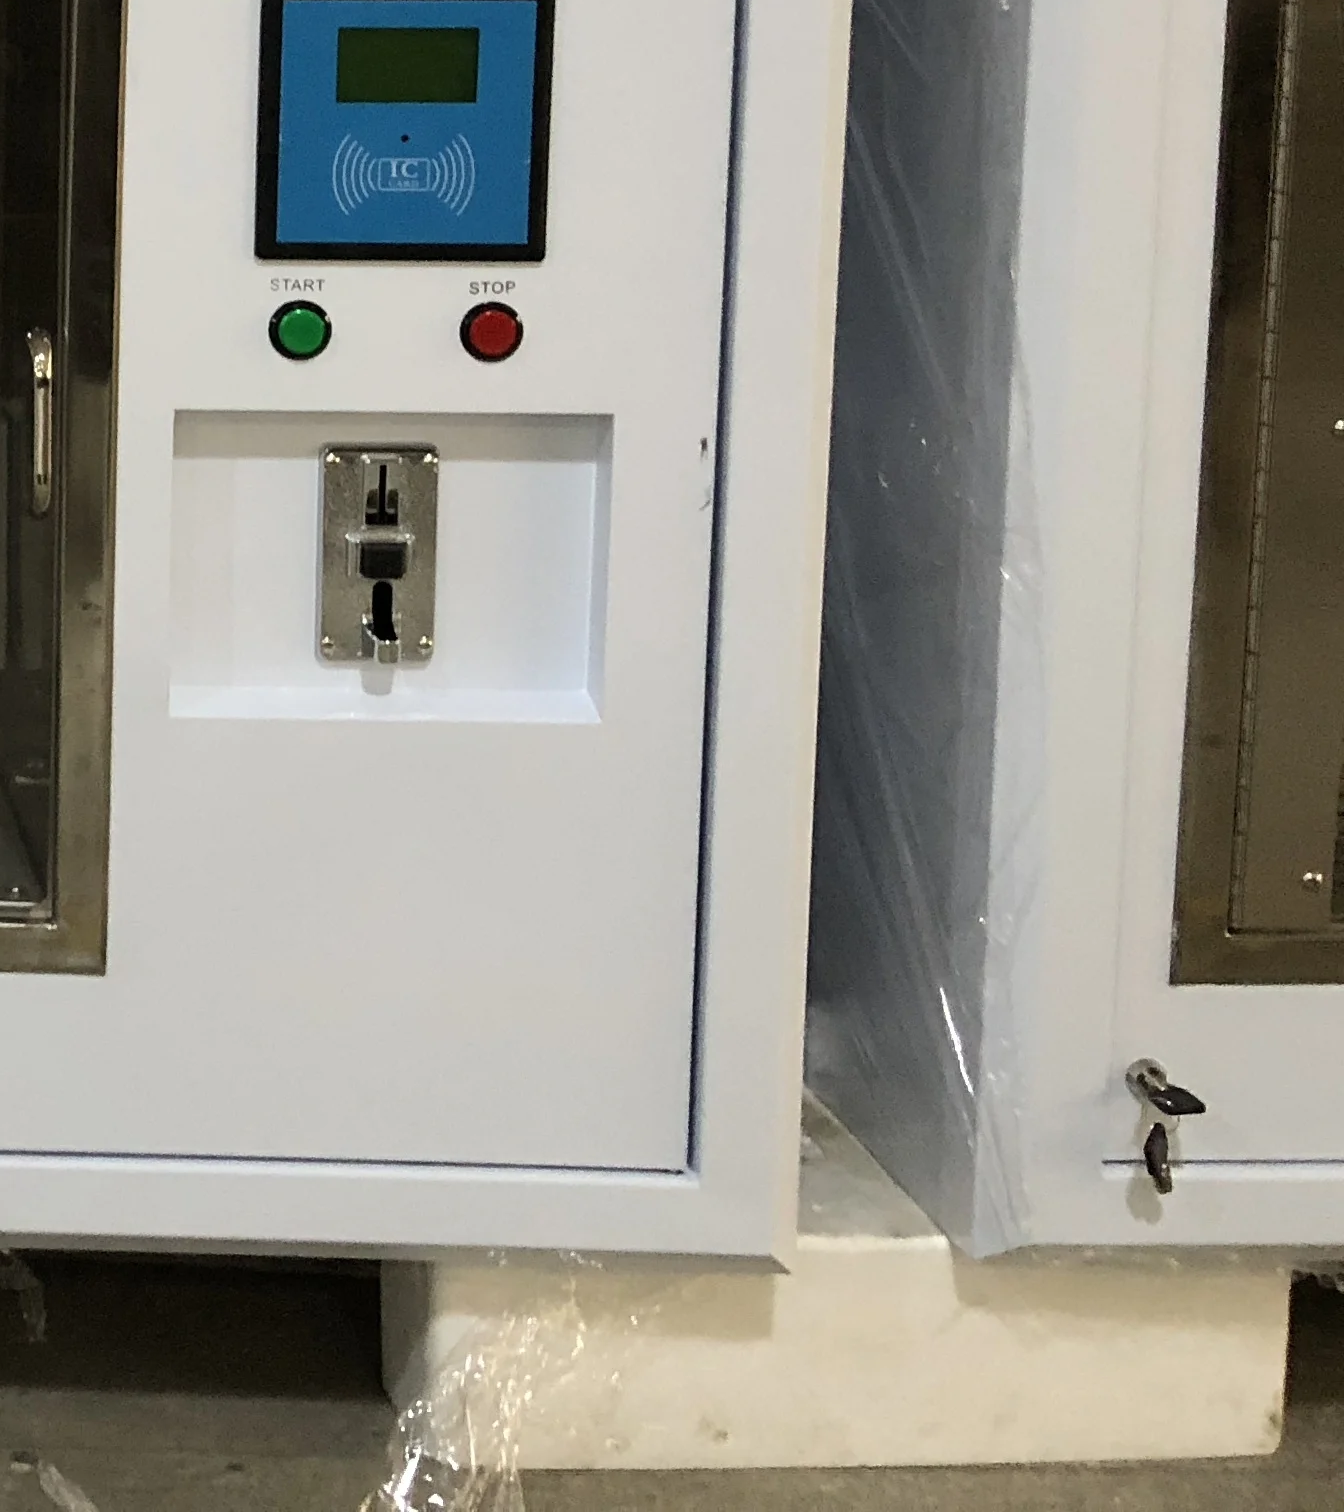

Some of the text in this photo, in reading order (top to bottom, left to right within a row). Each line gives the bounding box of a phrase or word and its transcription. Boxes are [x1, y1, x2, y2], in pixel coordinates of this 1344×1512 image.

[391, 158, 418, 178] IC
[269, 277, 326, 292] START
[468, 280, 517, 295] STOP
